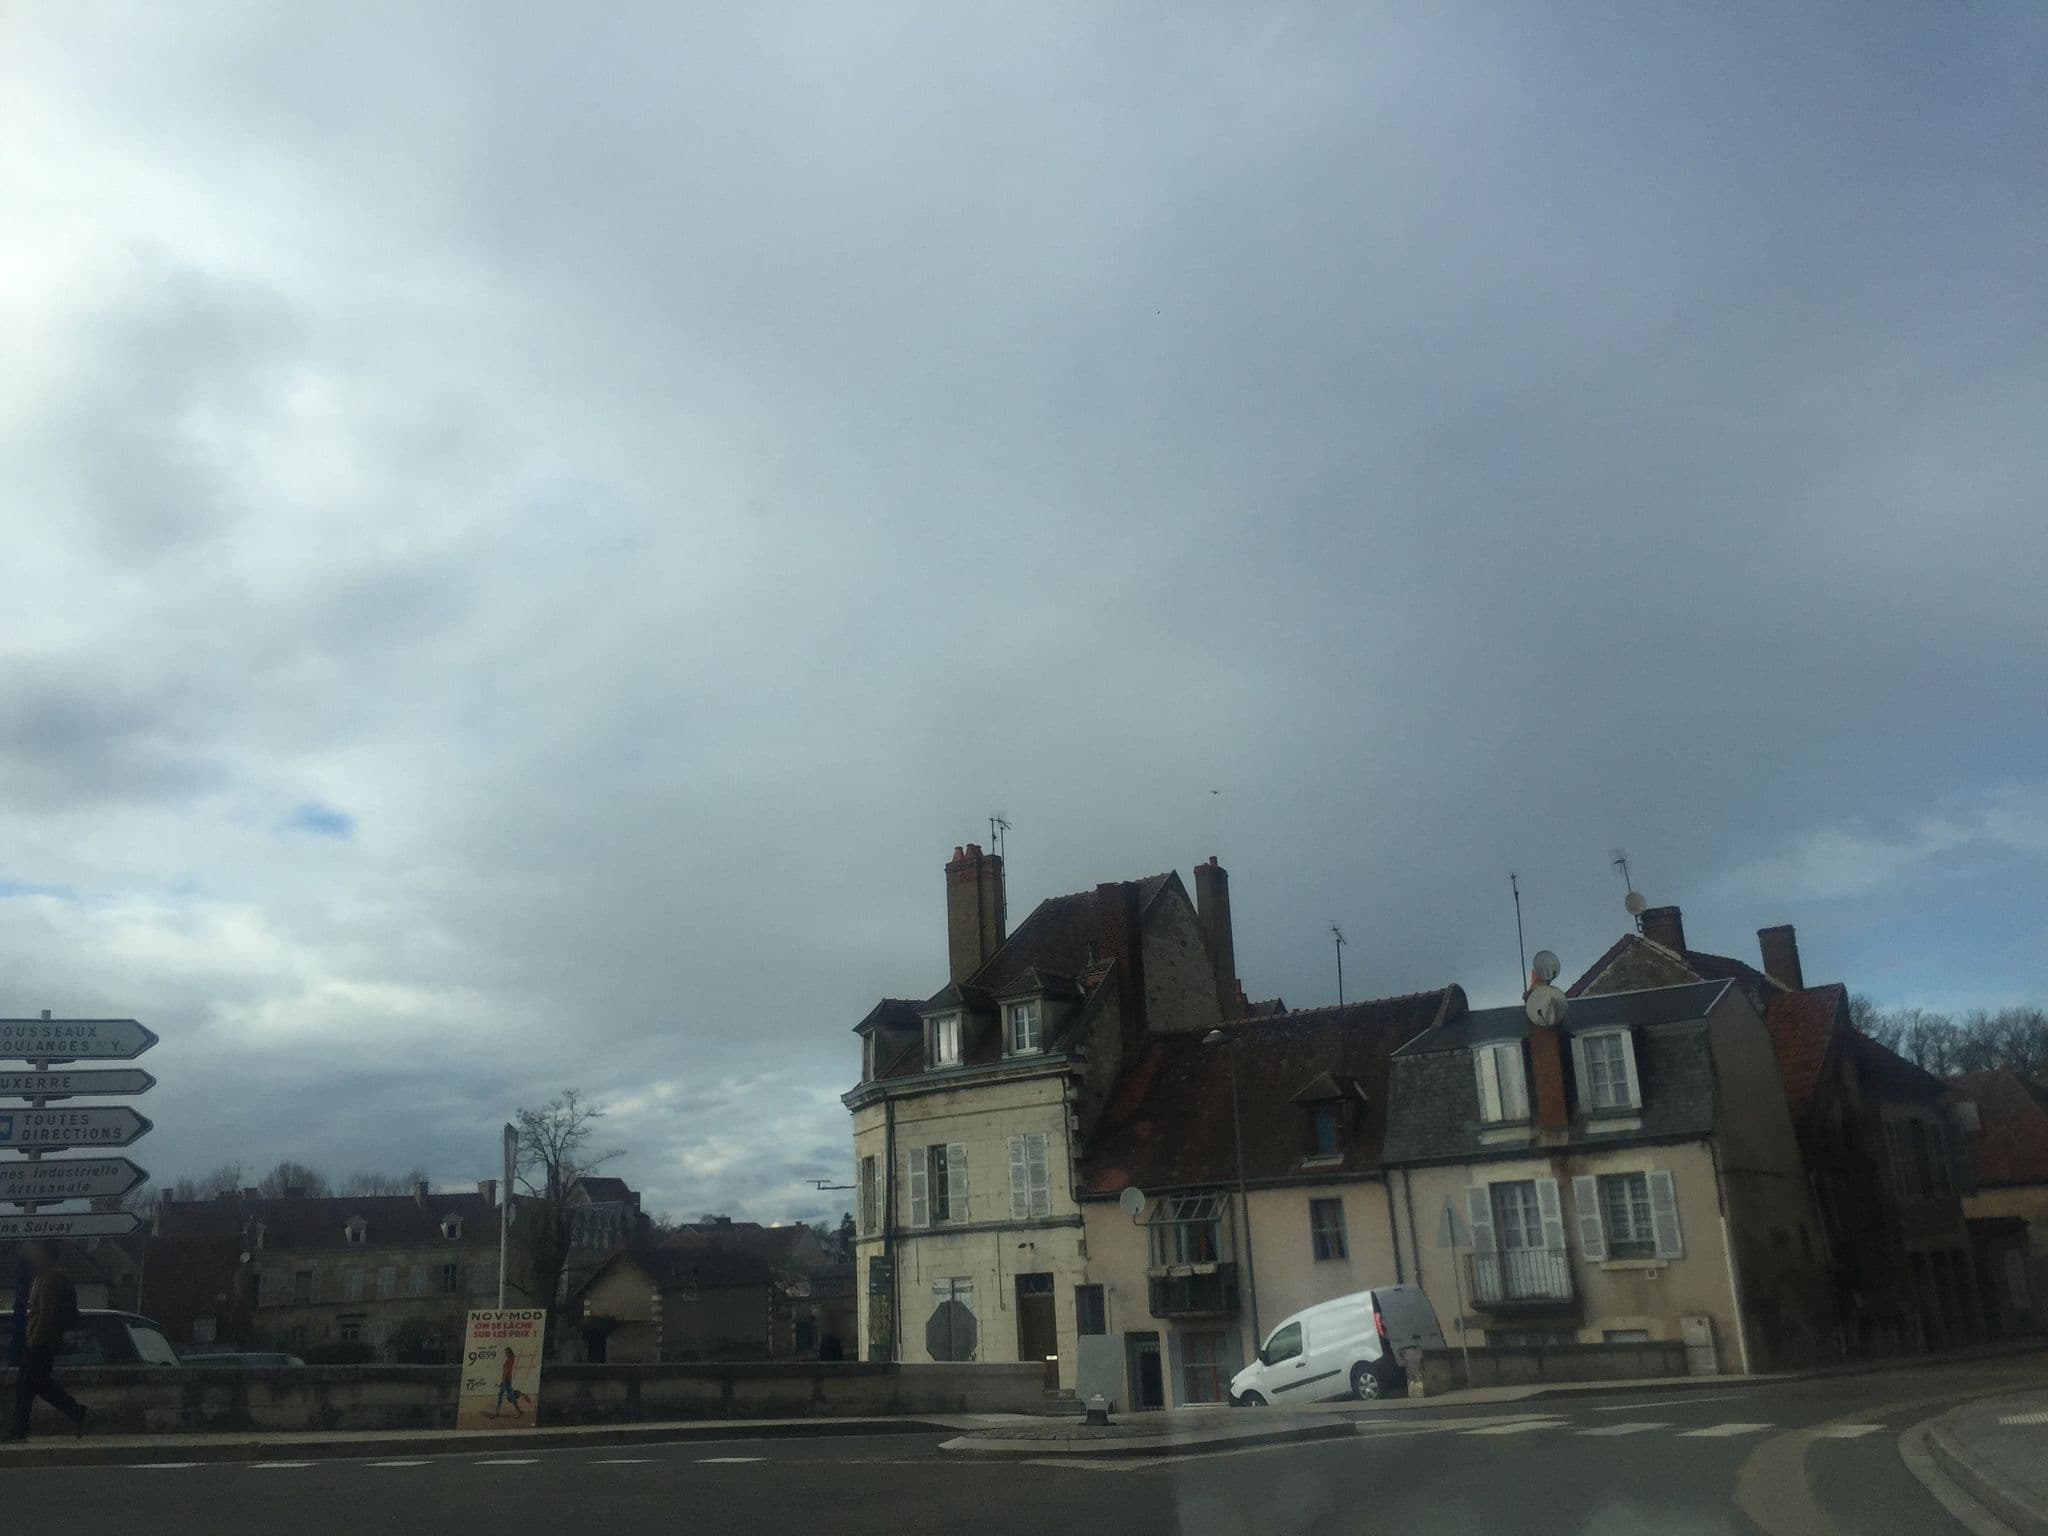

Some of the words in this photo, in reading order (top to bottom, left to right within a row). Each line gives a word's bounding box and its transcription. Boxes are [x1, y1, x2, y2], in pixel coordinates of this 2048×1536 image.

[24, 1114, 89, 1126] TOUTES
[22, 1127, 122, 1141] DIRECTIONS
[25, 1221, 73, 1233] Solvay
